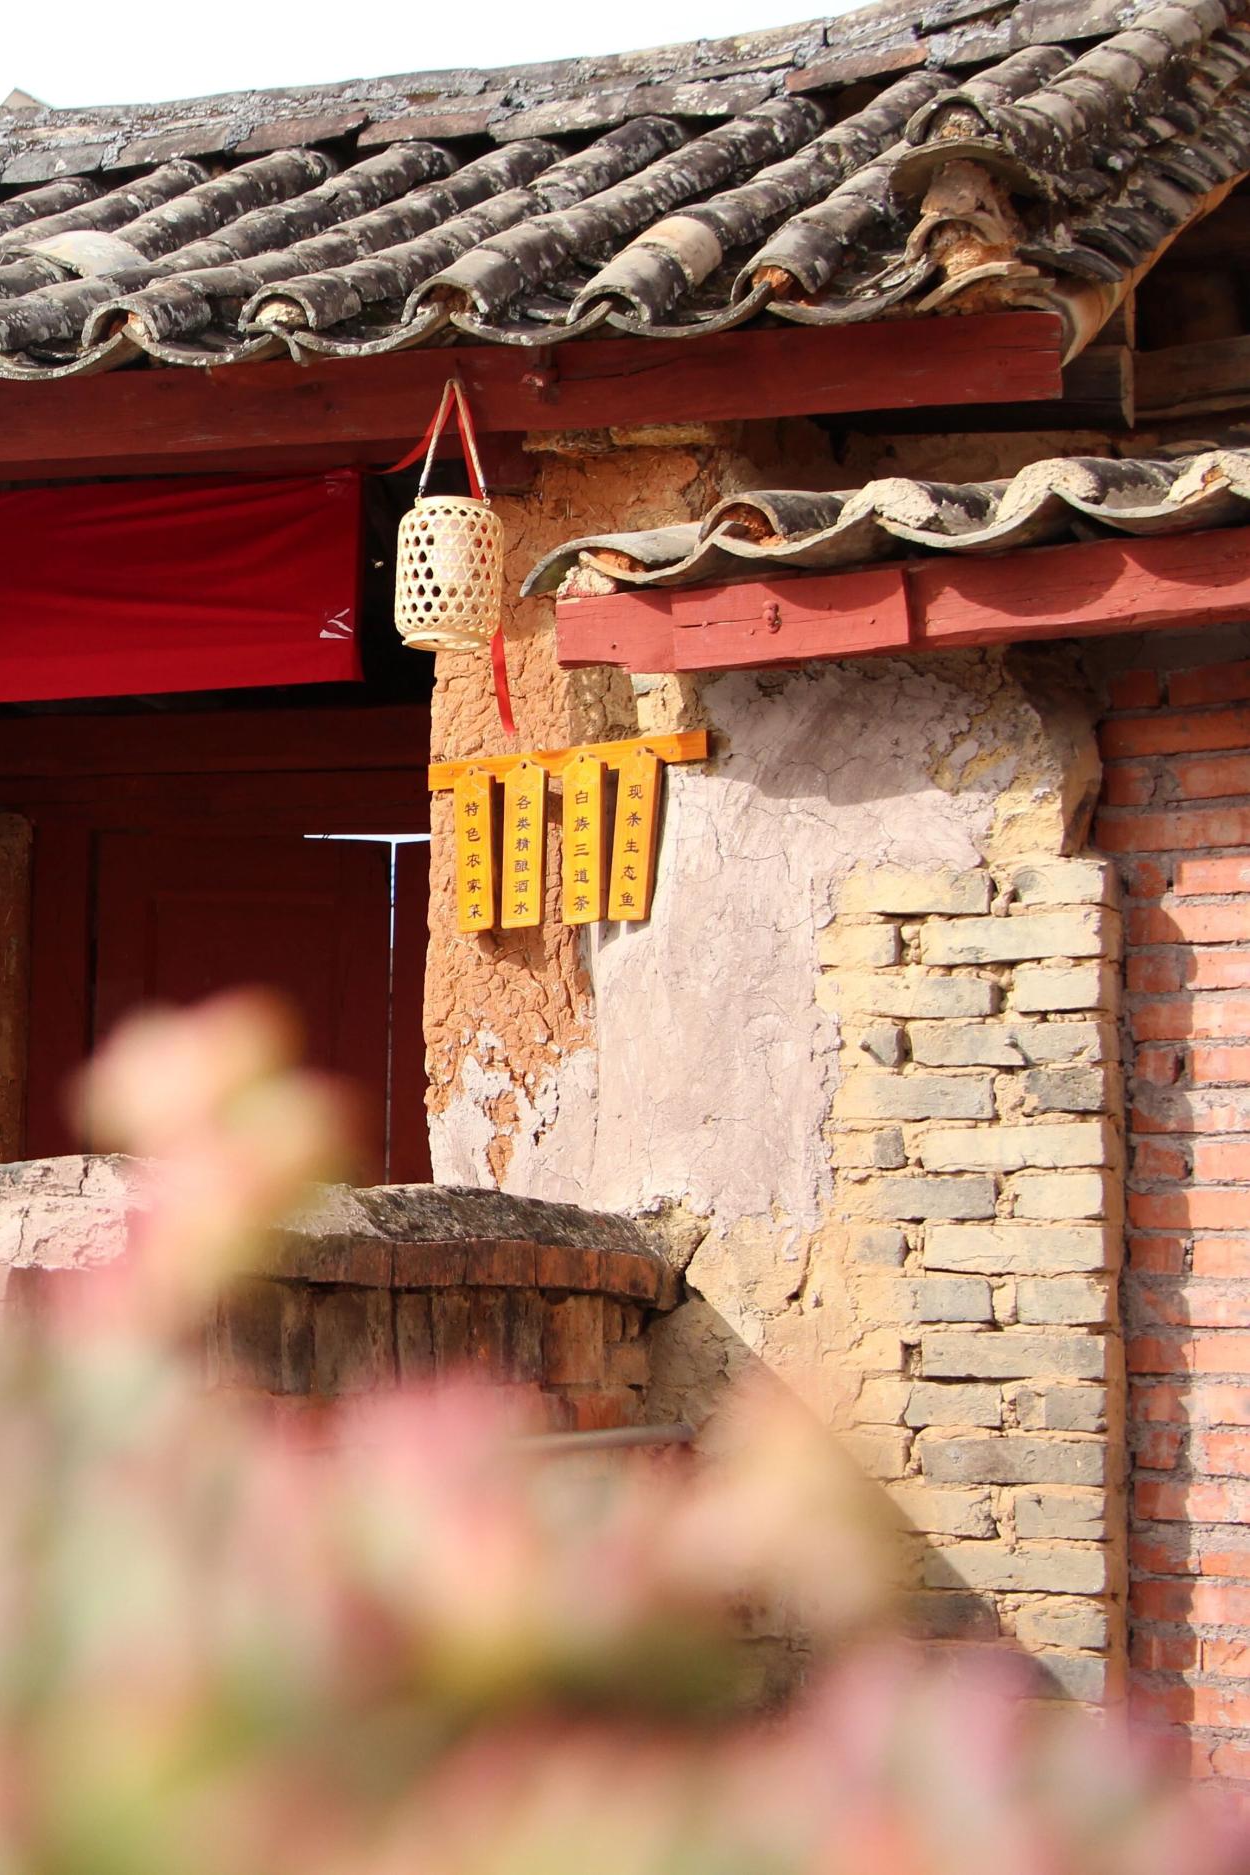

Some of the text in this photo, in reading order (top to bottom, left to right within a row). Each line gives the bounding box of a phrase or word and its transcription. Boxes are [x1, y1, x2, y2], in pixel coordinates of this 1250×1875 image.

[464, 801, 483, 919] 特色农家菜
[514, 795, 532, 915] 各类精酿酒水
[573, 790, 590, 912] 白族三道茶
[618, 784, 644, 908] 现杀生态鱼
